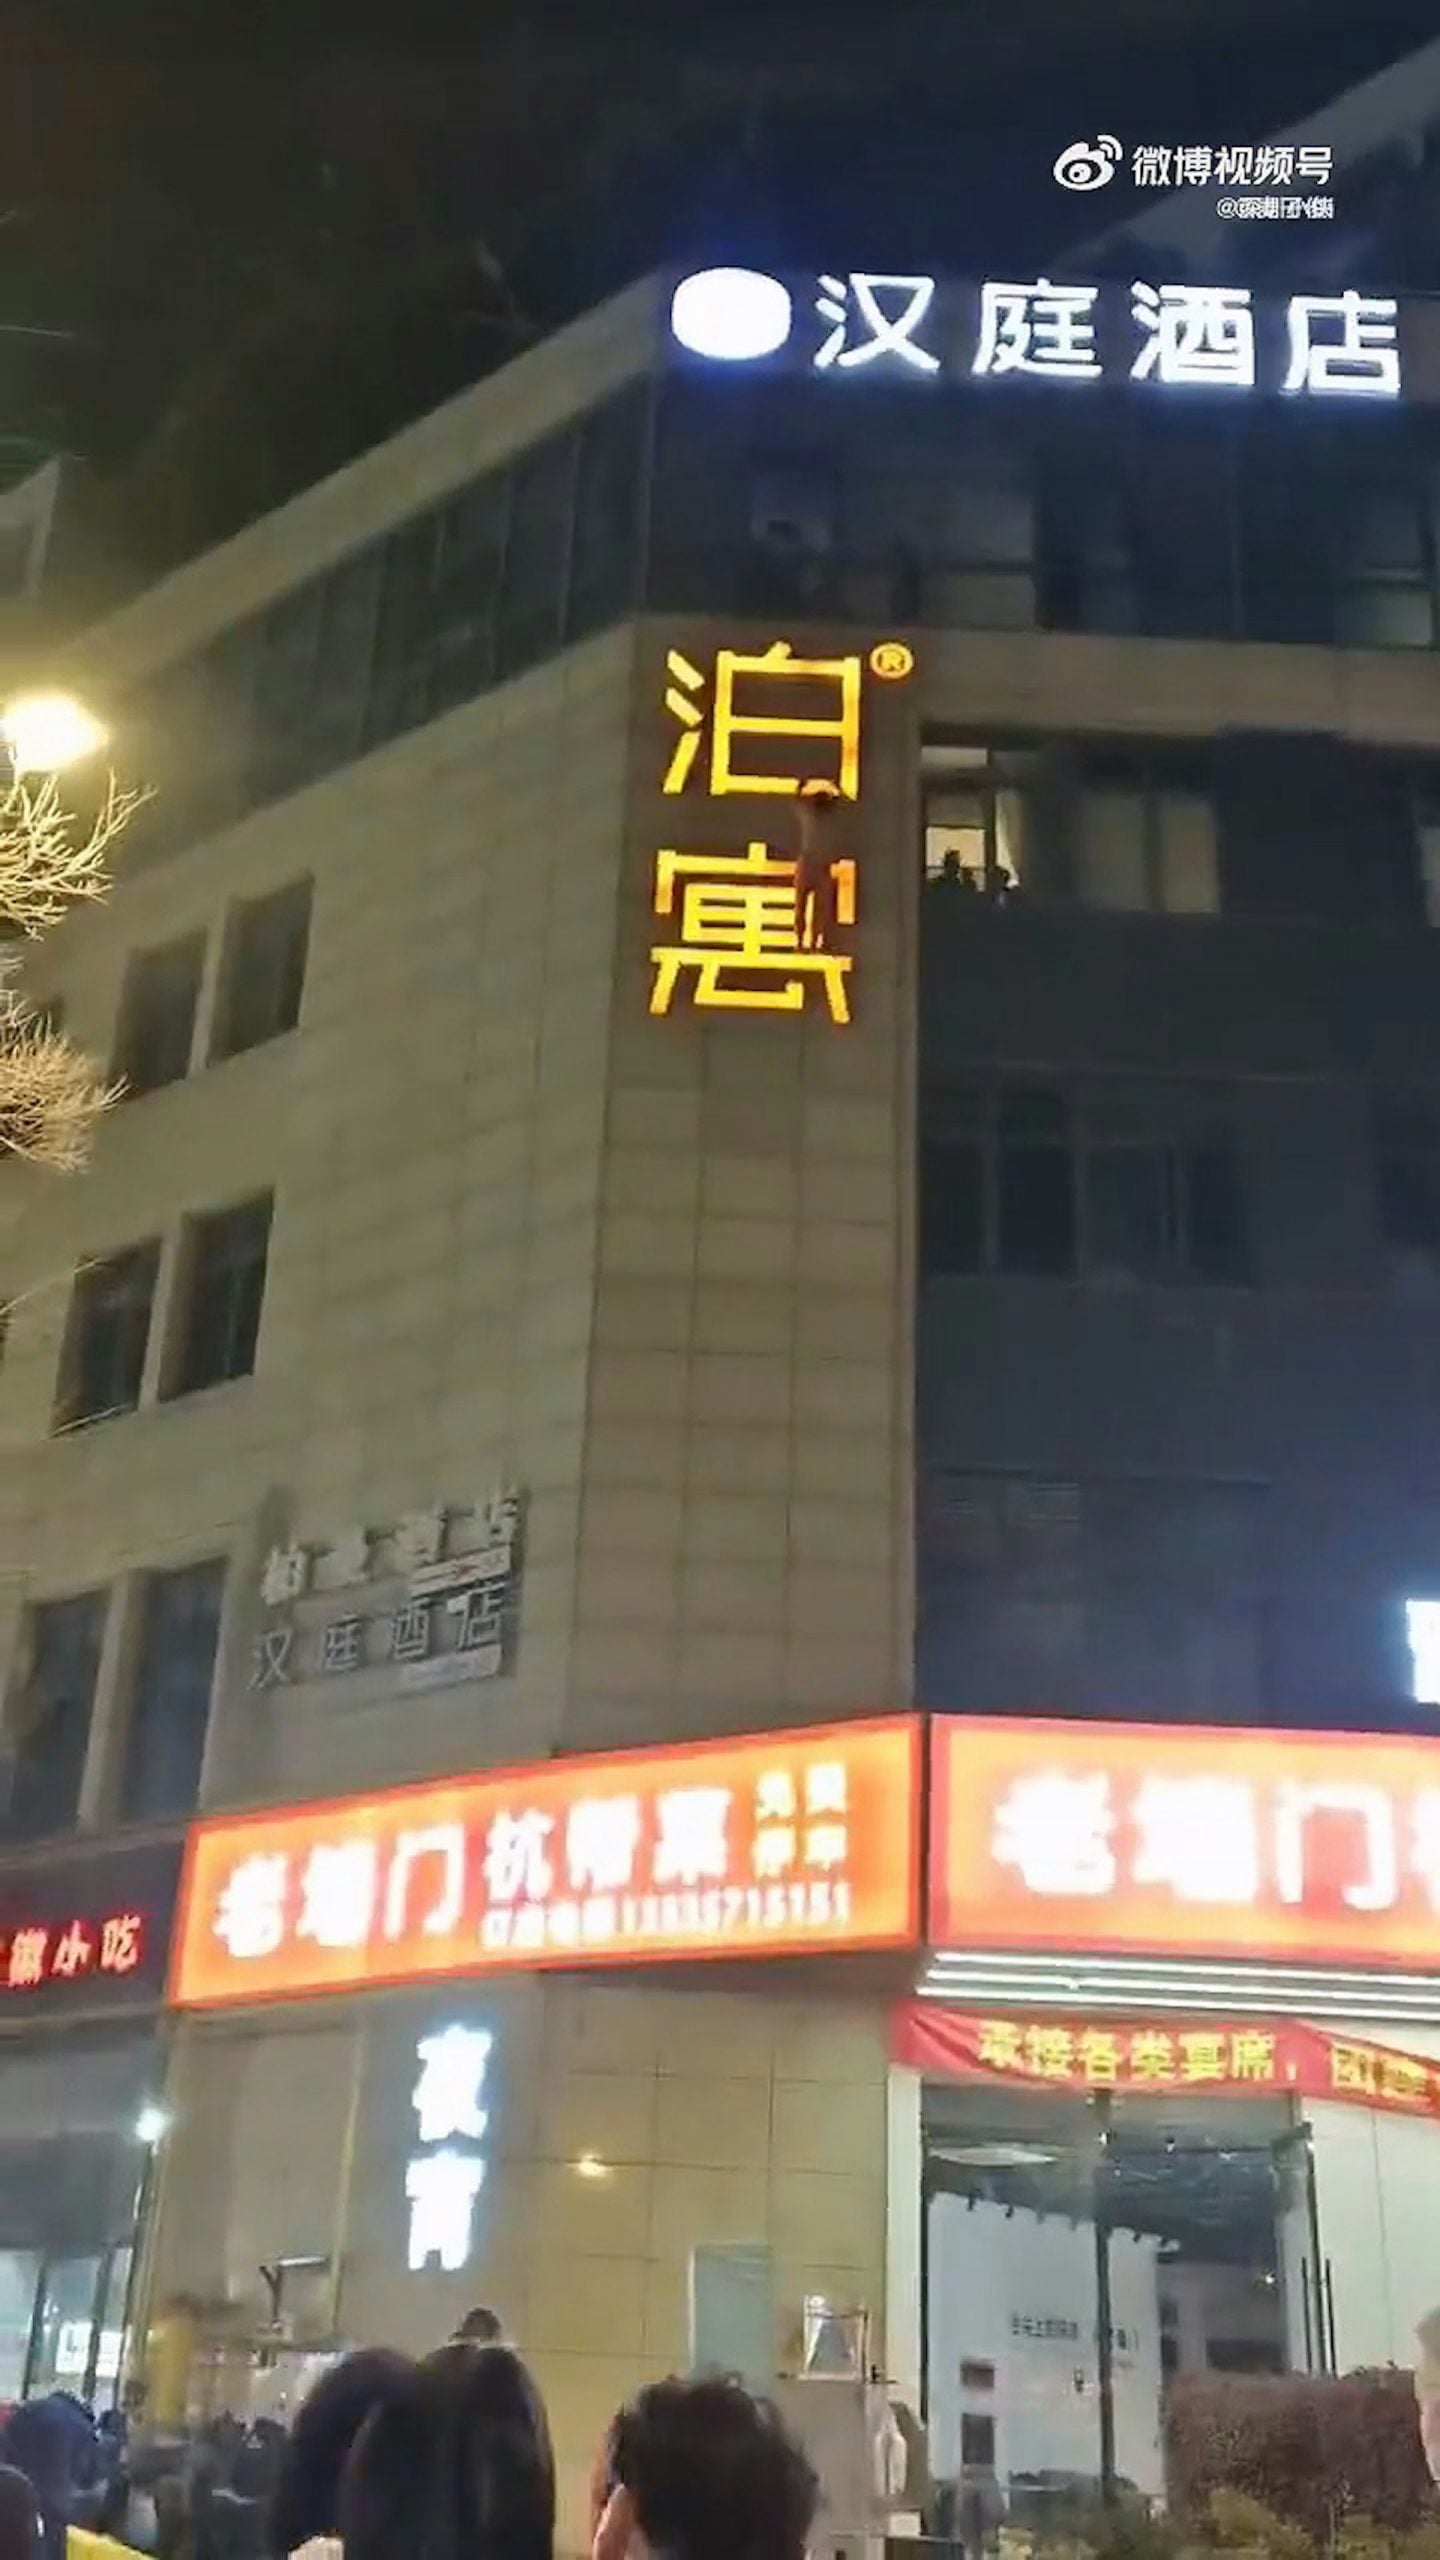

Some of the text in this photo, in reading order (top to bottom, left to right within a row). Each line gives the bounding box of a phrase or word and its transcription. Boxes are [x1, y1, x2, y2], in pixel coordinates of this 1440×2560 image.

[811, 271, 1401, 398] 汉庭酒店
[648, 640, 861, 1025] 泊寓
